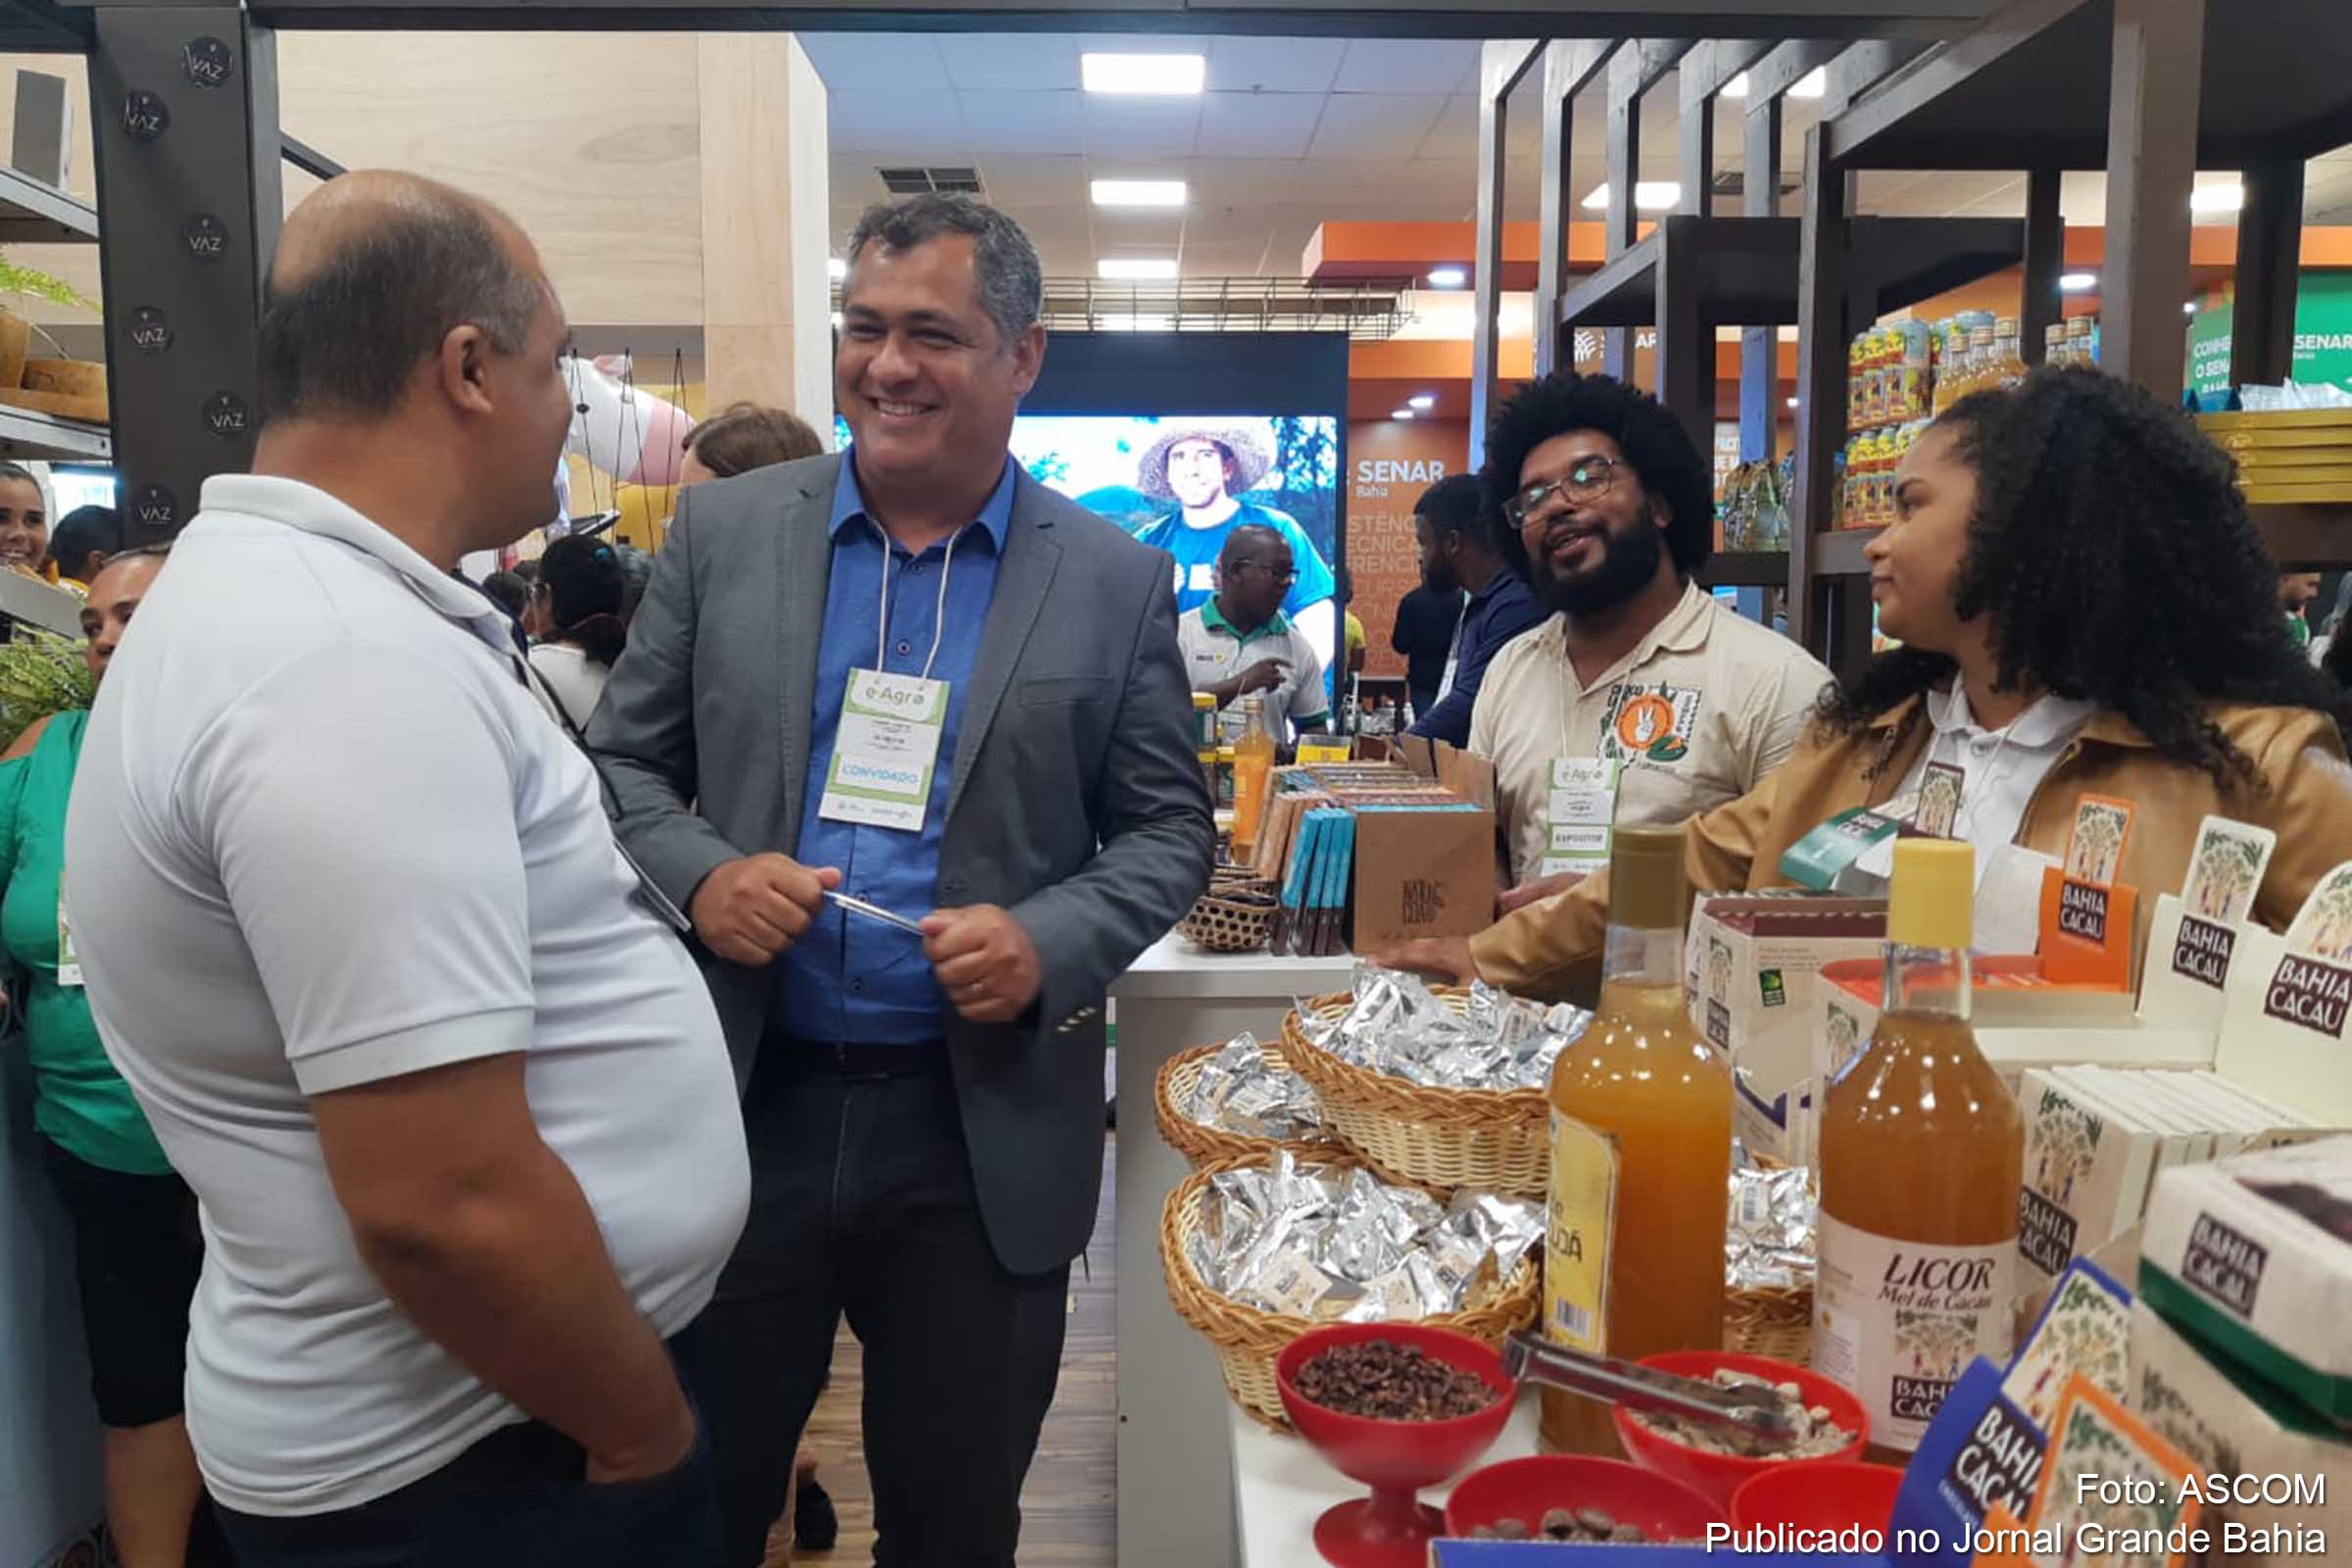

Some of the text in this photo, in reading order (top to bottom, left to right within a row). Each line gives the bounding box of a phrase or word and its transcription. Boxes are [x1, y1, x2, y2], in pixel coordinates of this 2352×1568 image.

[189, 237, 221, 251] VAZ
[132, 326, 166, 344] VAZ
[211, 412, 244, 428] VAZ
[1357, 460, 1446, 483] SENAR
[138, 504, 172, 521] VAZ
[842, 763, 919, 784] CONVIDADO
[2062, 883, 2105, 916] BAHIA
[2061, 906, 2103, 939] CACAU
[2180, 920, 2230, 959] BAHIA
[2176, 946, 2227, 981] CACAU
[2277, 958, 2352, 1004] BAHIA
[2270, 986, 2343, 1030] CACAU
[2021, 1227, 2067, 1274] ACAU
[2193, 1217, 2261, 1278] BAHIA
[1884, 1253, 1995, 1292] LICOR
[2187, 1250, 2251, 1308] CACAU
[1878, 1285, 1993, 1311] Mel de Cacau
